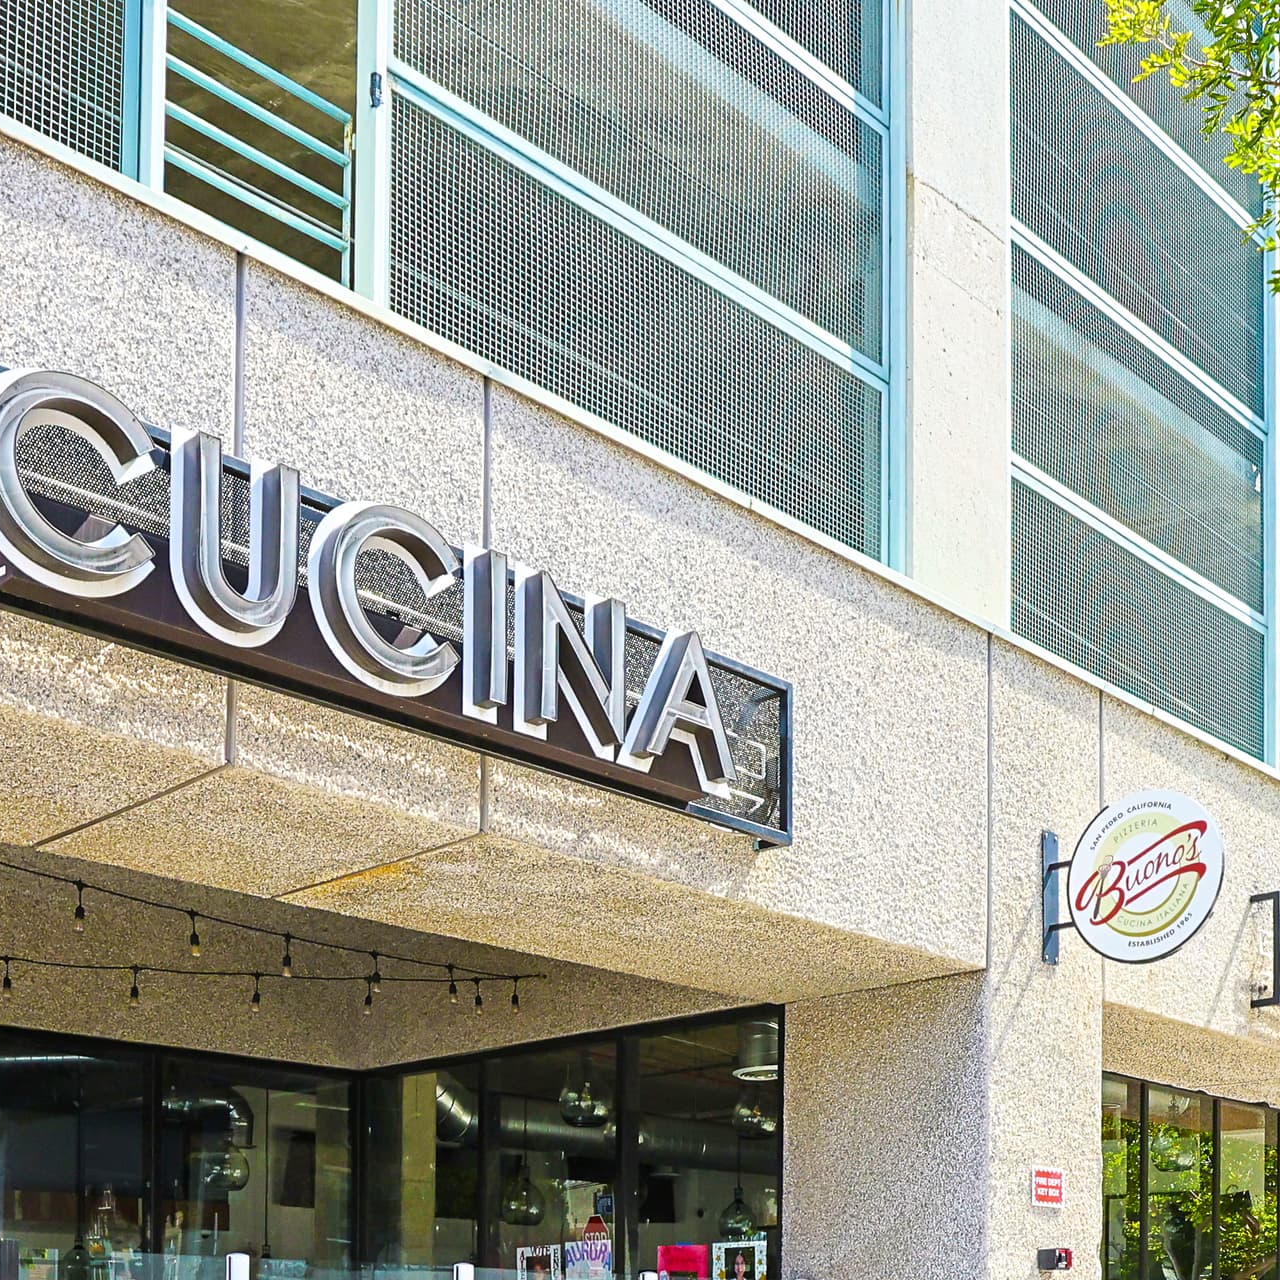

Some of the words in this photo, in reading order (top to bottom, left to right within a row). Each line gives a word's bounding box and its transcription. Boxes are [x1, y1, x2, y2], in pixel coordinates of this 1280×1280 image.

[1089, 834, 1101, 851] SAN
[1102, 812, 1124, 835] PEDRO
[1126, 801, 1173, 814] CALIFORNIA
[1113, 819, 1159, 843] PIZZERIA
[1075, 822, 1207, 926] Buono's
[1117, 914, 1154, 928] CUCINA
[1156, 882, 1189, 922] ITALIANA
[1128, 928, 1176, 948] ESTABLISHED
[1176, 911, 1194, 929] 1965
[565, 1241, 611, 1272] AURORA
